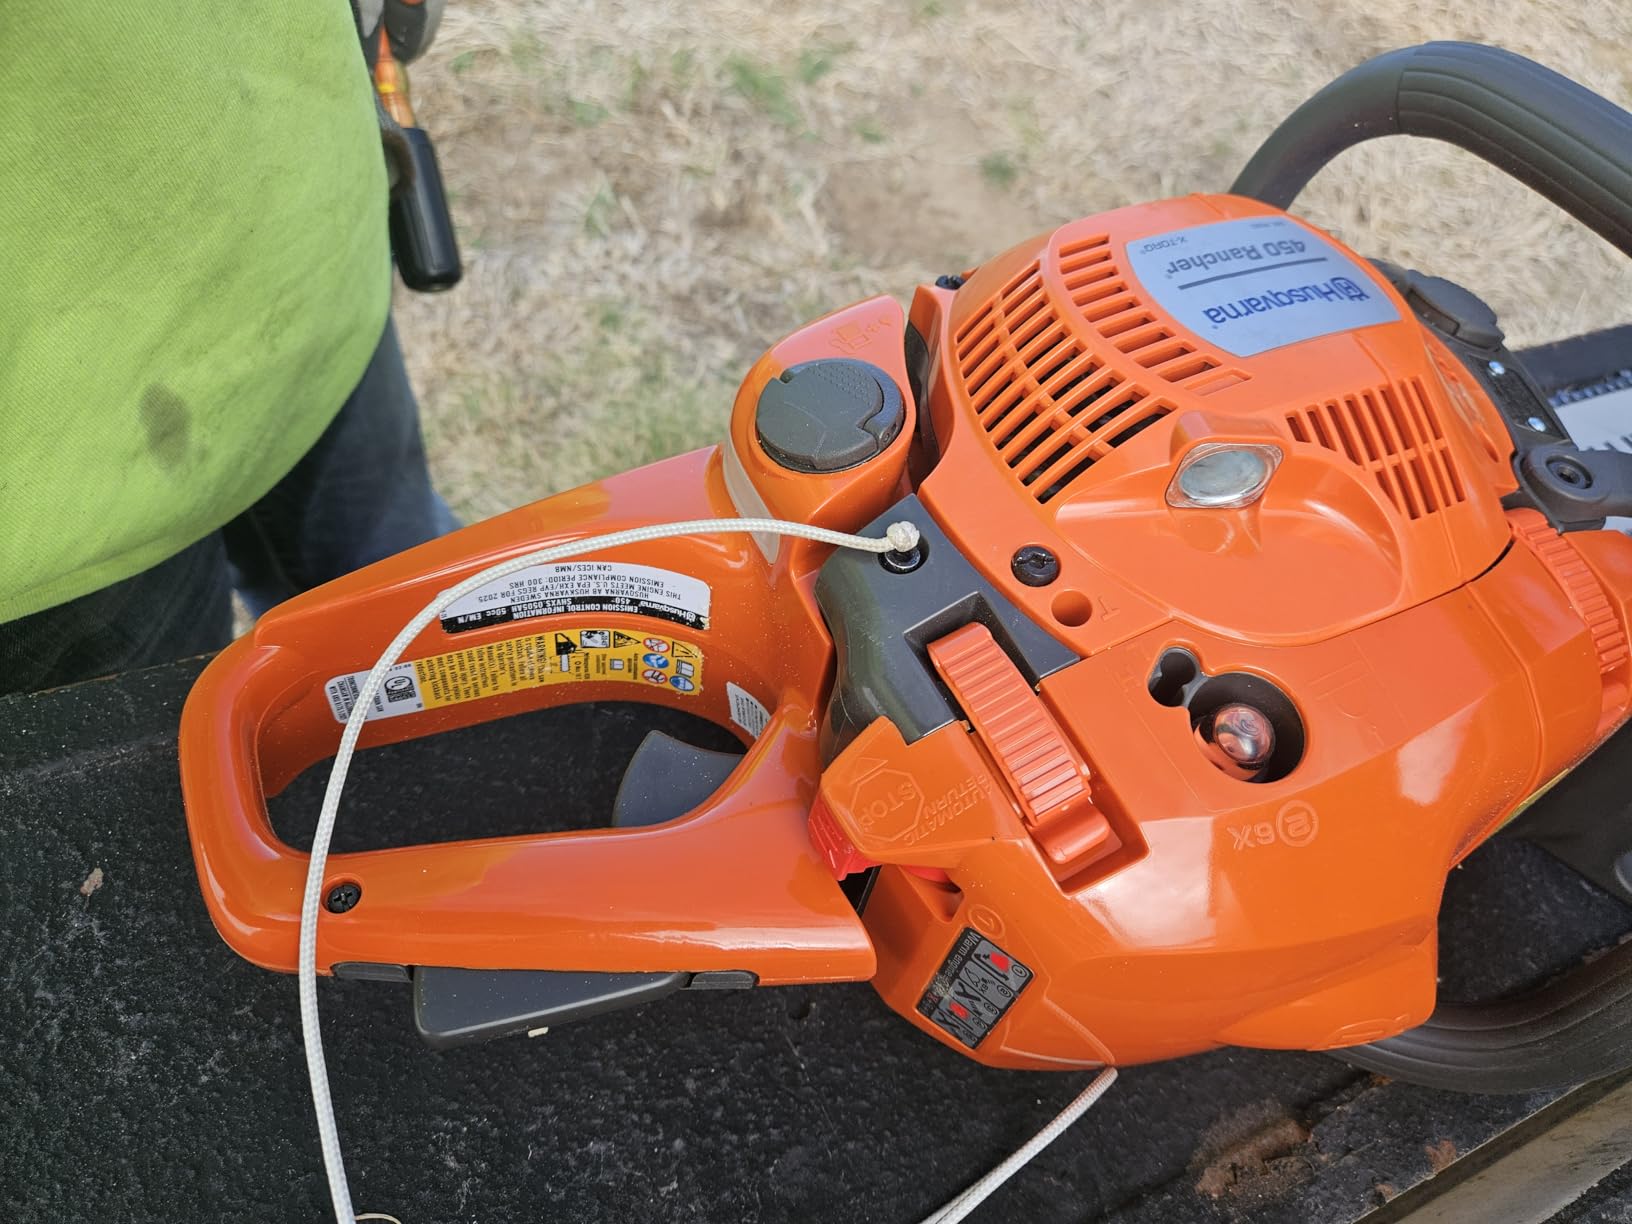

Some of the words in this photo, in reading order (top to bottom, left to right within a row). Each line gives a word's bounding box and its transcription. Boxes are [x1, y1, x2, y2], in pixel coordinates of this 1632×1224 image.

[1262, 239, 1306, 258] 450
[1166, 245, 1263, 276] Rancher
[1202, 282, 1340, 324] Husqvarna
[509, 580, 524, 589] HRS
[629, 576, 663, 588] EMISSION
[500, 590, 515, 598] FOR
[517, 586, 537, 594] REGS
[545, 588, 589, 597] HUSKVARNA
[605, 589, 649, 598] HUSQVARNA
[638, 585, 663, 595] ENGINE
[478, 593, 498, 602] 2025
[510, 592, 540, 603] SWEDEN
[666, 591, 681, 600] THIS
[512, 605, 565, 619] INFORMATION
[567, 603, 600, 612] CONTROL
[602, 604, 638, 613] EMISSION
[639, 601, 686, 617] Husqvarna
[860, 782, 917, 832] STOP
[903, 782, 993, 846] AUTOMATIC
[959, 931, 981, 957] Warm
